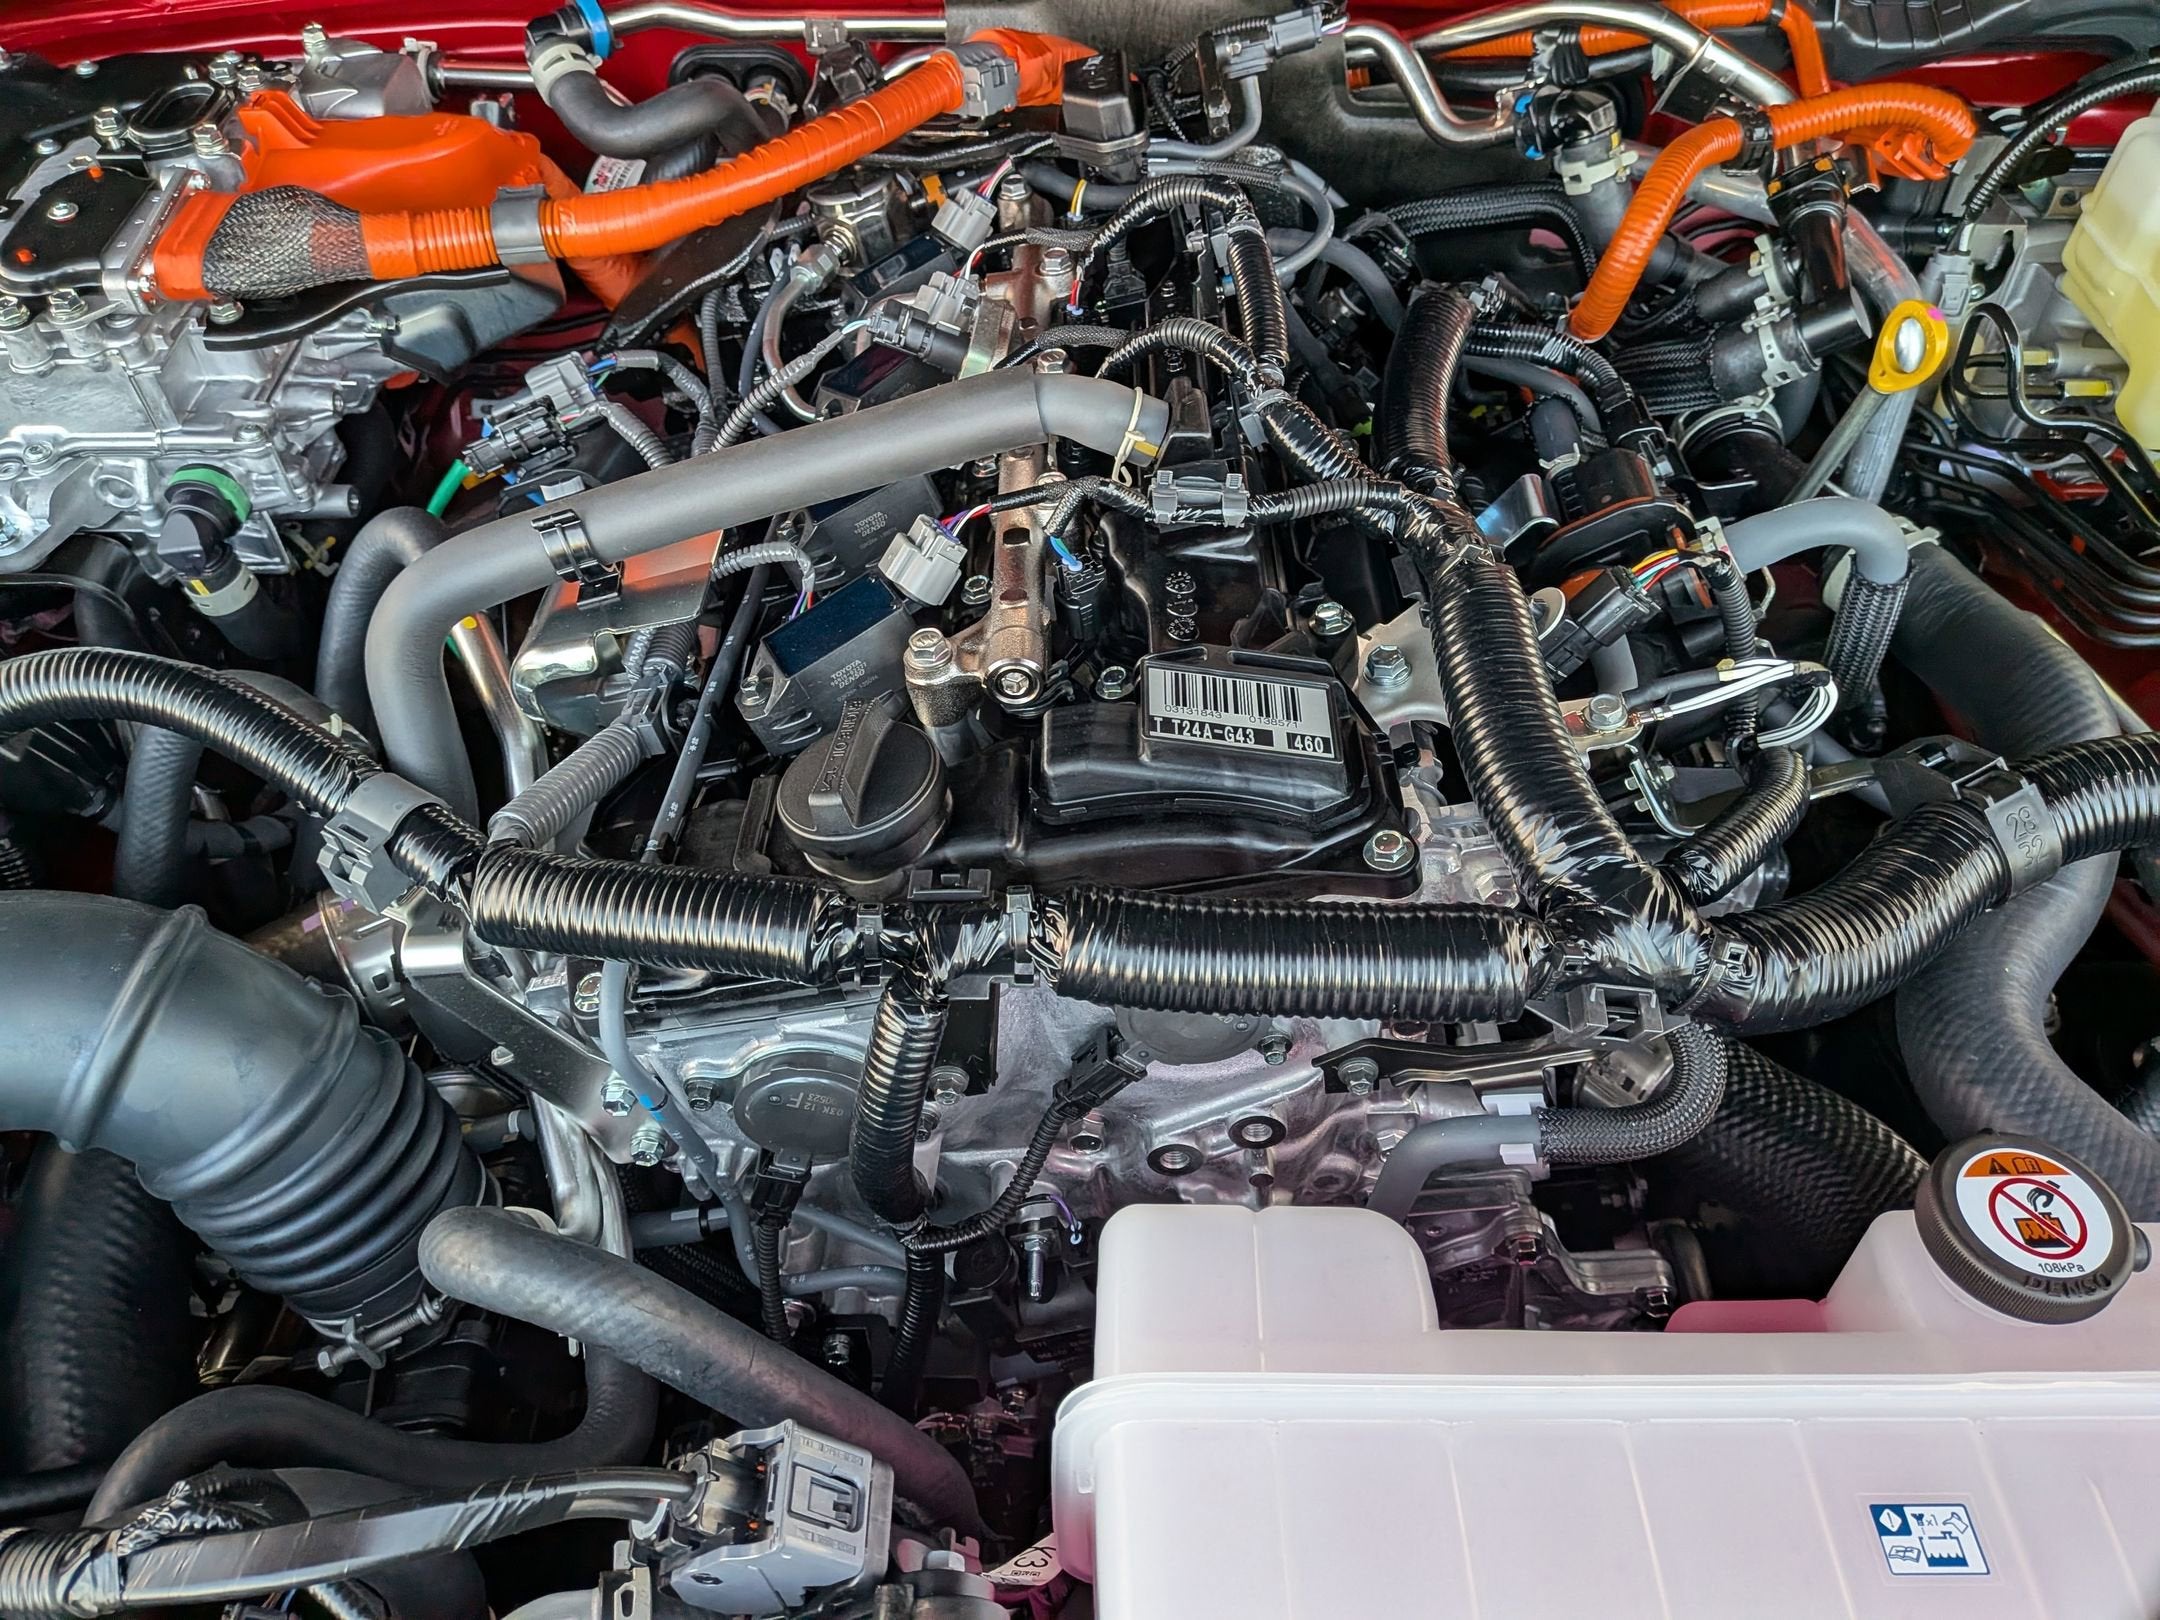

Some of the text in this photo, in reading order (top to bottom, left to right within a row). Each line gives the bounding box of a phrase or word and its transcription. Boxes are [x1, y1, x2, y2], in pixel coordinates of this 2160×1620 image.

[854, 511, 883, 528] TOYOTA
[861, 520, 886, 537] DENSO
[830, 660, 862, 680] TOYOTA
[839, 669, 865, 689] DENSO
[1164, 705, 1299, 728] 03131843 0138571
[1153, 717, 1324, 753] T T24A-G43 460
[2006, 805, 2040, 842] 28
[2038, 1262, 2086, 1274] 108kPa
[2025, 1272, 2112, 1298] DENSO
